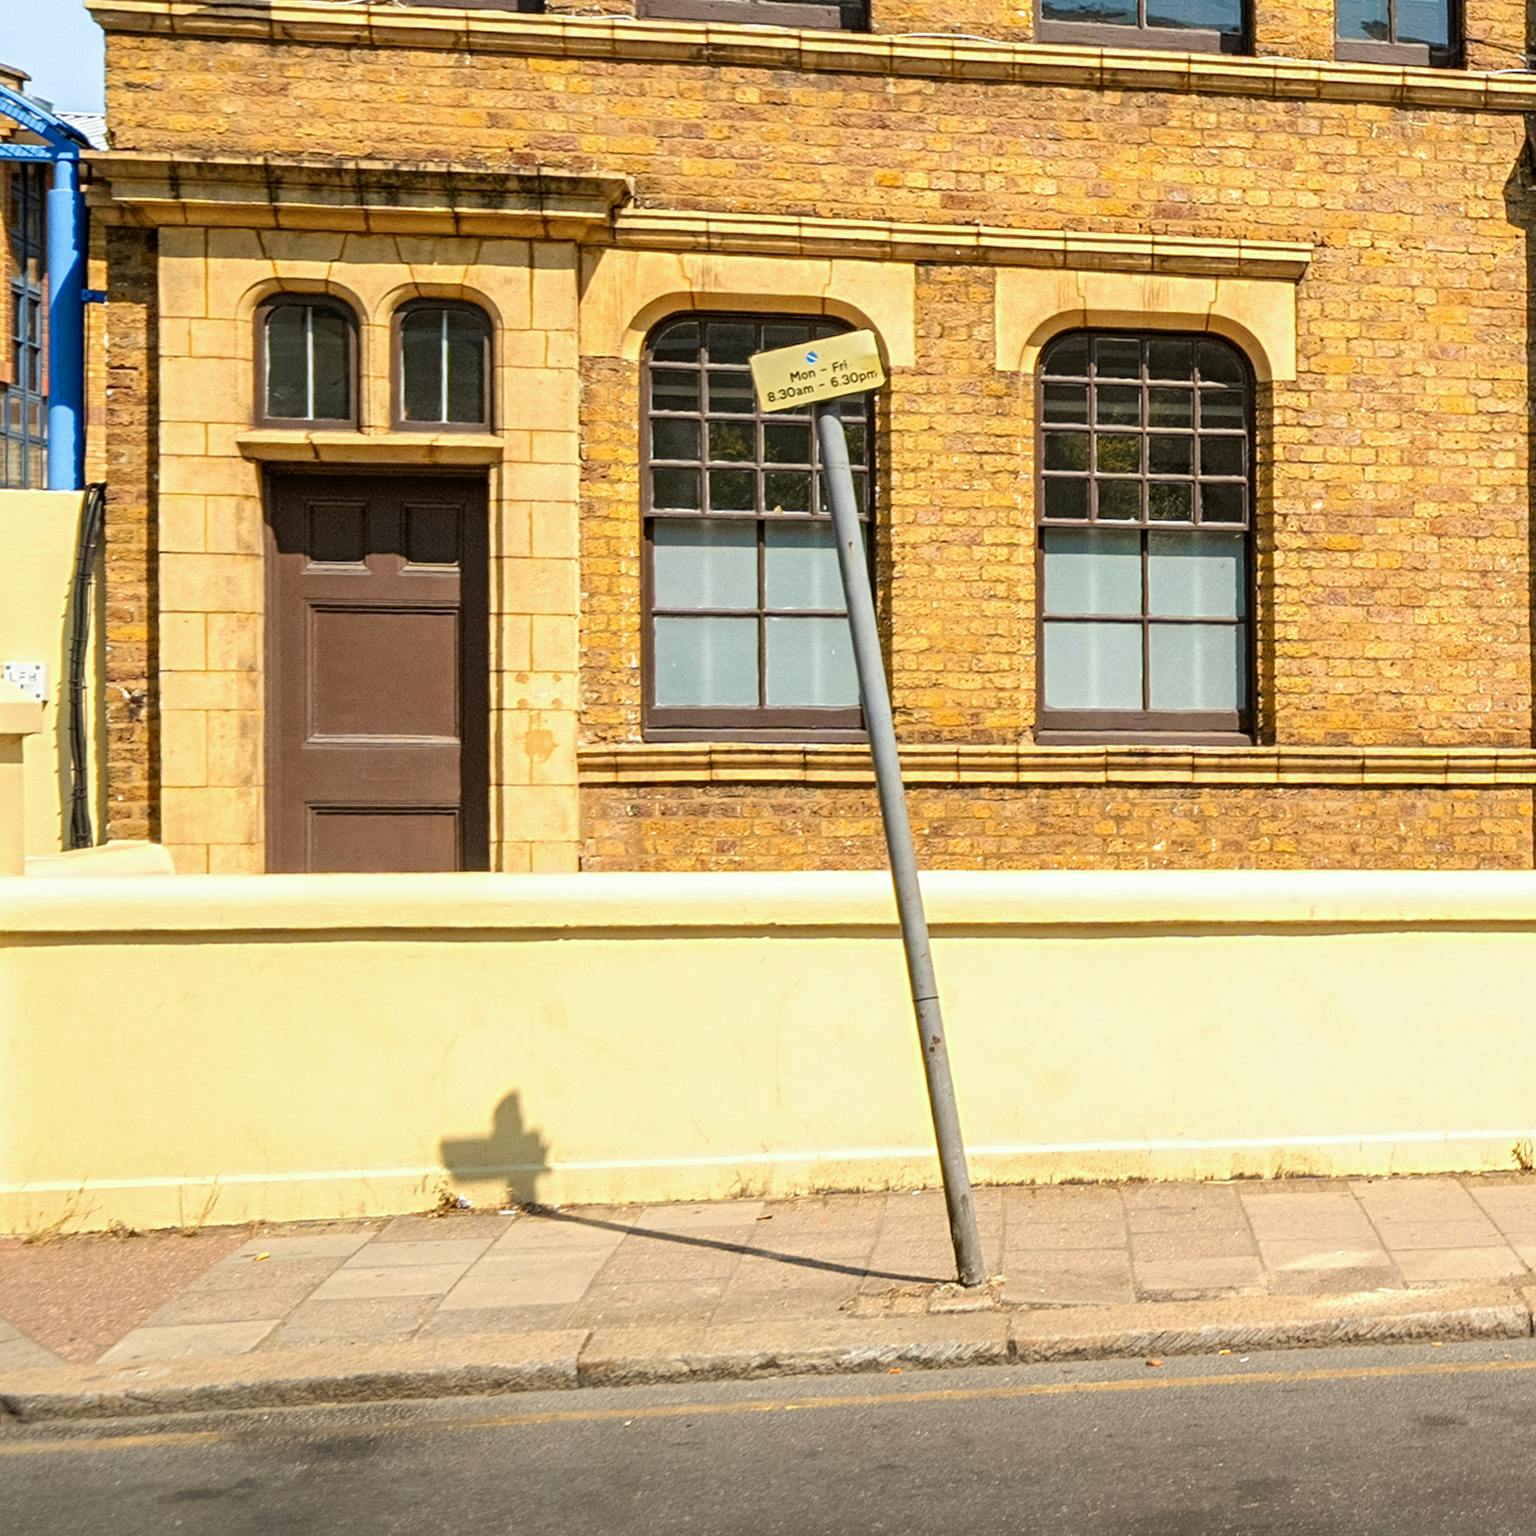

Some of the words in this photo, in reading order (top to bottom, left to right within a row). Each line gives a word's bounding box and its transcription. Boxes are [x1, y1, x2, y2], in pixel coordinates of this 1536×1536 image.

[789, 368, 816, 383] Mon
[831, 360, 848, 373] Fri
[767, 385, 815, 403] 8.30am
[830, 370, 878, 389] 6.30pm
